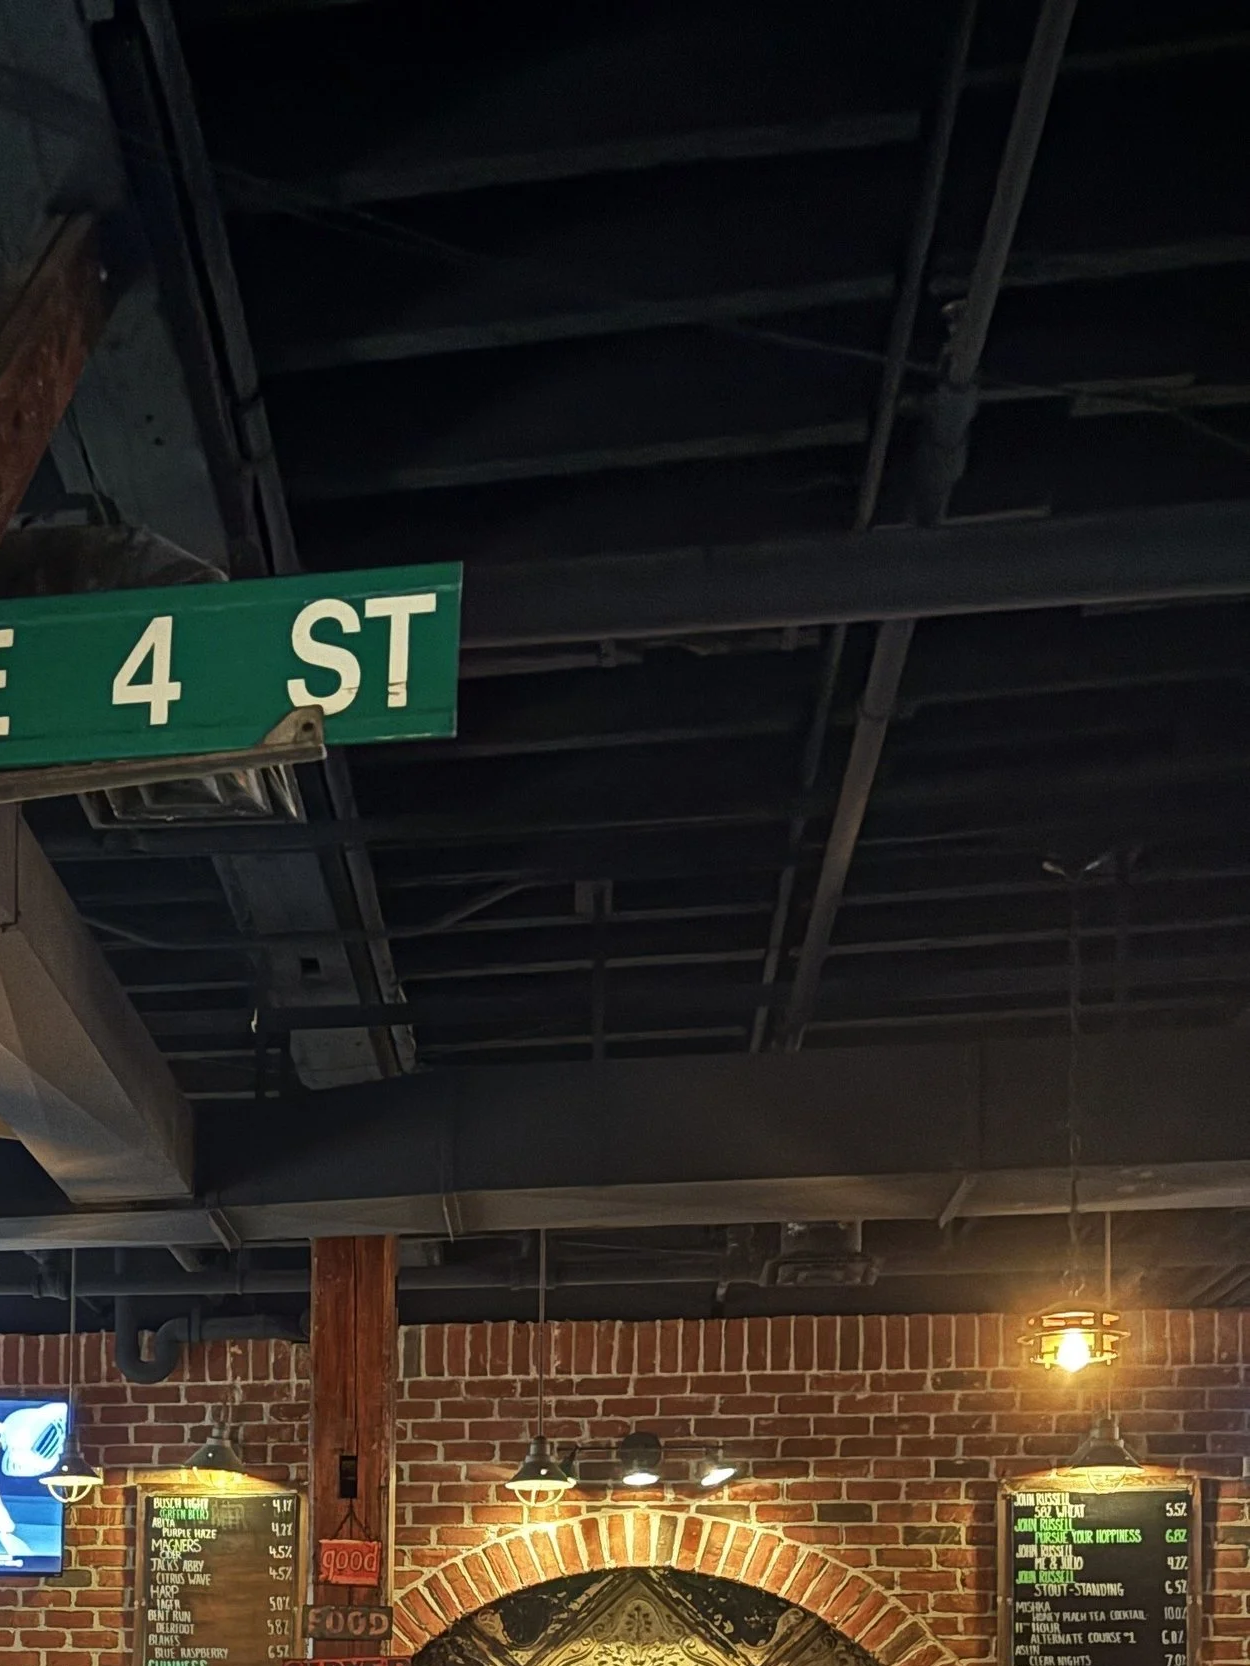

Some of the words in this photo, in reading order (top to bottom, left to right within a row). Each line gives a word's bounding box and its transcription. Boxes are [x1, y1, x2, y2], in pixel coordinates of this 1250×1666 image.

[112, 615, 182, 725] 4
[287, 593, 437, 716] ST
[153, 1498, 181, 1509] BUSCH
[184, 1498, 209, 1509] LIGHT
[1014, 1493, 1035, 1506] JOHN
[1036, 1493, 1070, 1506] RUSSELL
[1056, 1504, 1086, 1518] WHEAT
[152, 1517, 175, 1528] ABITA
[1014, 1519, 1037, 1532] JOHN
[1039, 1518, 1075, 1532] RUSSELL
[162, 1528, 191, 1538] PURPLE
[194, 1529, 217, 1539] HAZE
[1035, 1531, 1068, 1544] PURSUE
[1071, 1530, 1094, 1543] YOUR
[1096, 1529, 1142, 1543] HOPPINESS
[151, 1539, 202, 1552] MAGNERS
[1016, 1545, 1038, 1558] JOHN
[1040, 1545, 1075, 1557] RUSSELL
[183, 1560, 204, 1572] ABBY
[322, 1548, 377, 1580] good
[1049, 1556, 1059, 1570] &
[156, 1573, 185, 1584] CITRUS
[188, 1574, 211, 1585] WAVE
[1039, 1570, 1076, 1583] RUSSELL
[150, 1585, 179, 1599] HARP
[1034, 1583, 1125, 1597] STOUT-STANDING
[1015, 1601, 1051, 1613] MISHKA
[148, 1610, 168, 1621] BENT
[173, 1611, 191, 1622] RUN
[308, 1610, 389, 1635] FOOD
[1089, 1611, 1106, 1622] TEA
[1031, 1622, 1061, 1634] HOUR
[1030, 1632, 1084, 1645] ALTERNATE
[1087, 1632, 1121, 1644] COURSE
[155, 1648, 175, 1658] BLUE
[180, 1648, 229, 1659] RASPBERRY
[1029, 1655, 1056, 1666] CLEAR
[1057, 1655, 1092, 1666] NIGHTS
